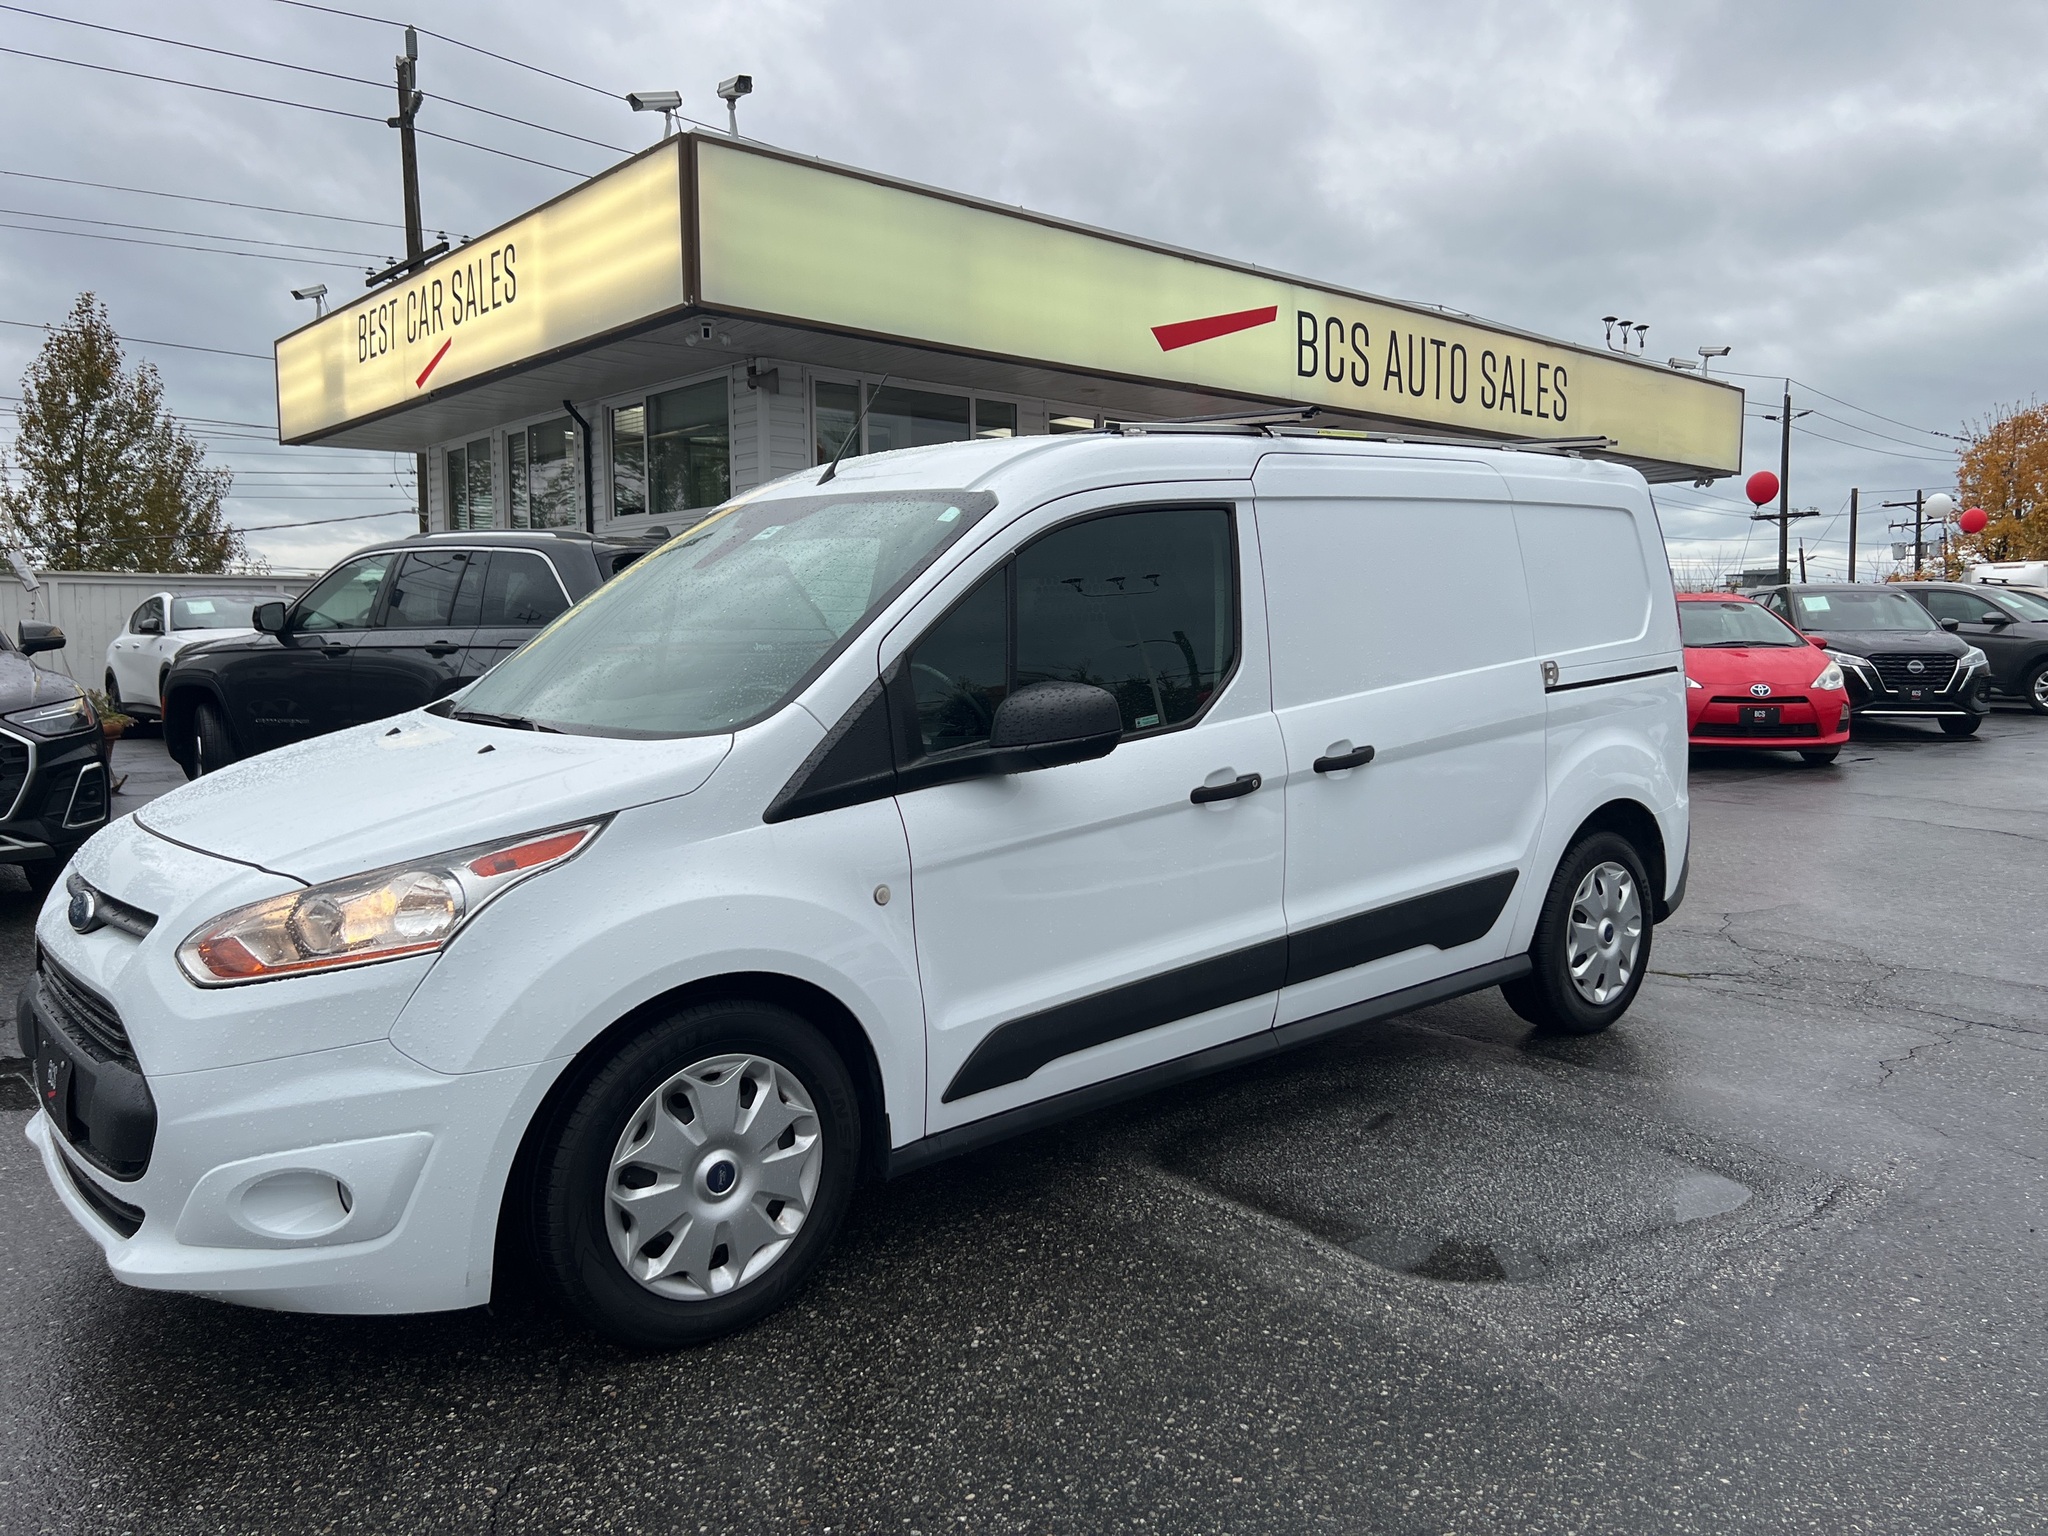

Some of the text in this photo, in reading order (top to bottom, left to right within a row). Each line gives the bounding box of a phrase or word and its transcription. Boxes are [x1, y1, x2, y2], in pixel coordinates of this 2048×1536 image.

[358, 243, 517, 364] BEST CAR SALES
[1297, 310, 1568, 422] BCS AUTO SALES
